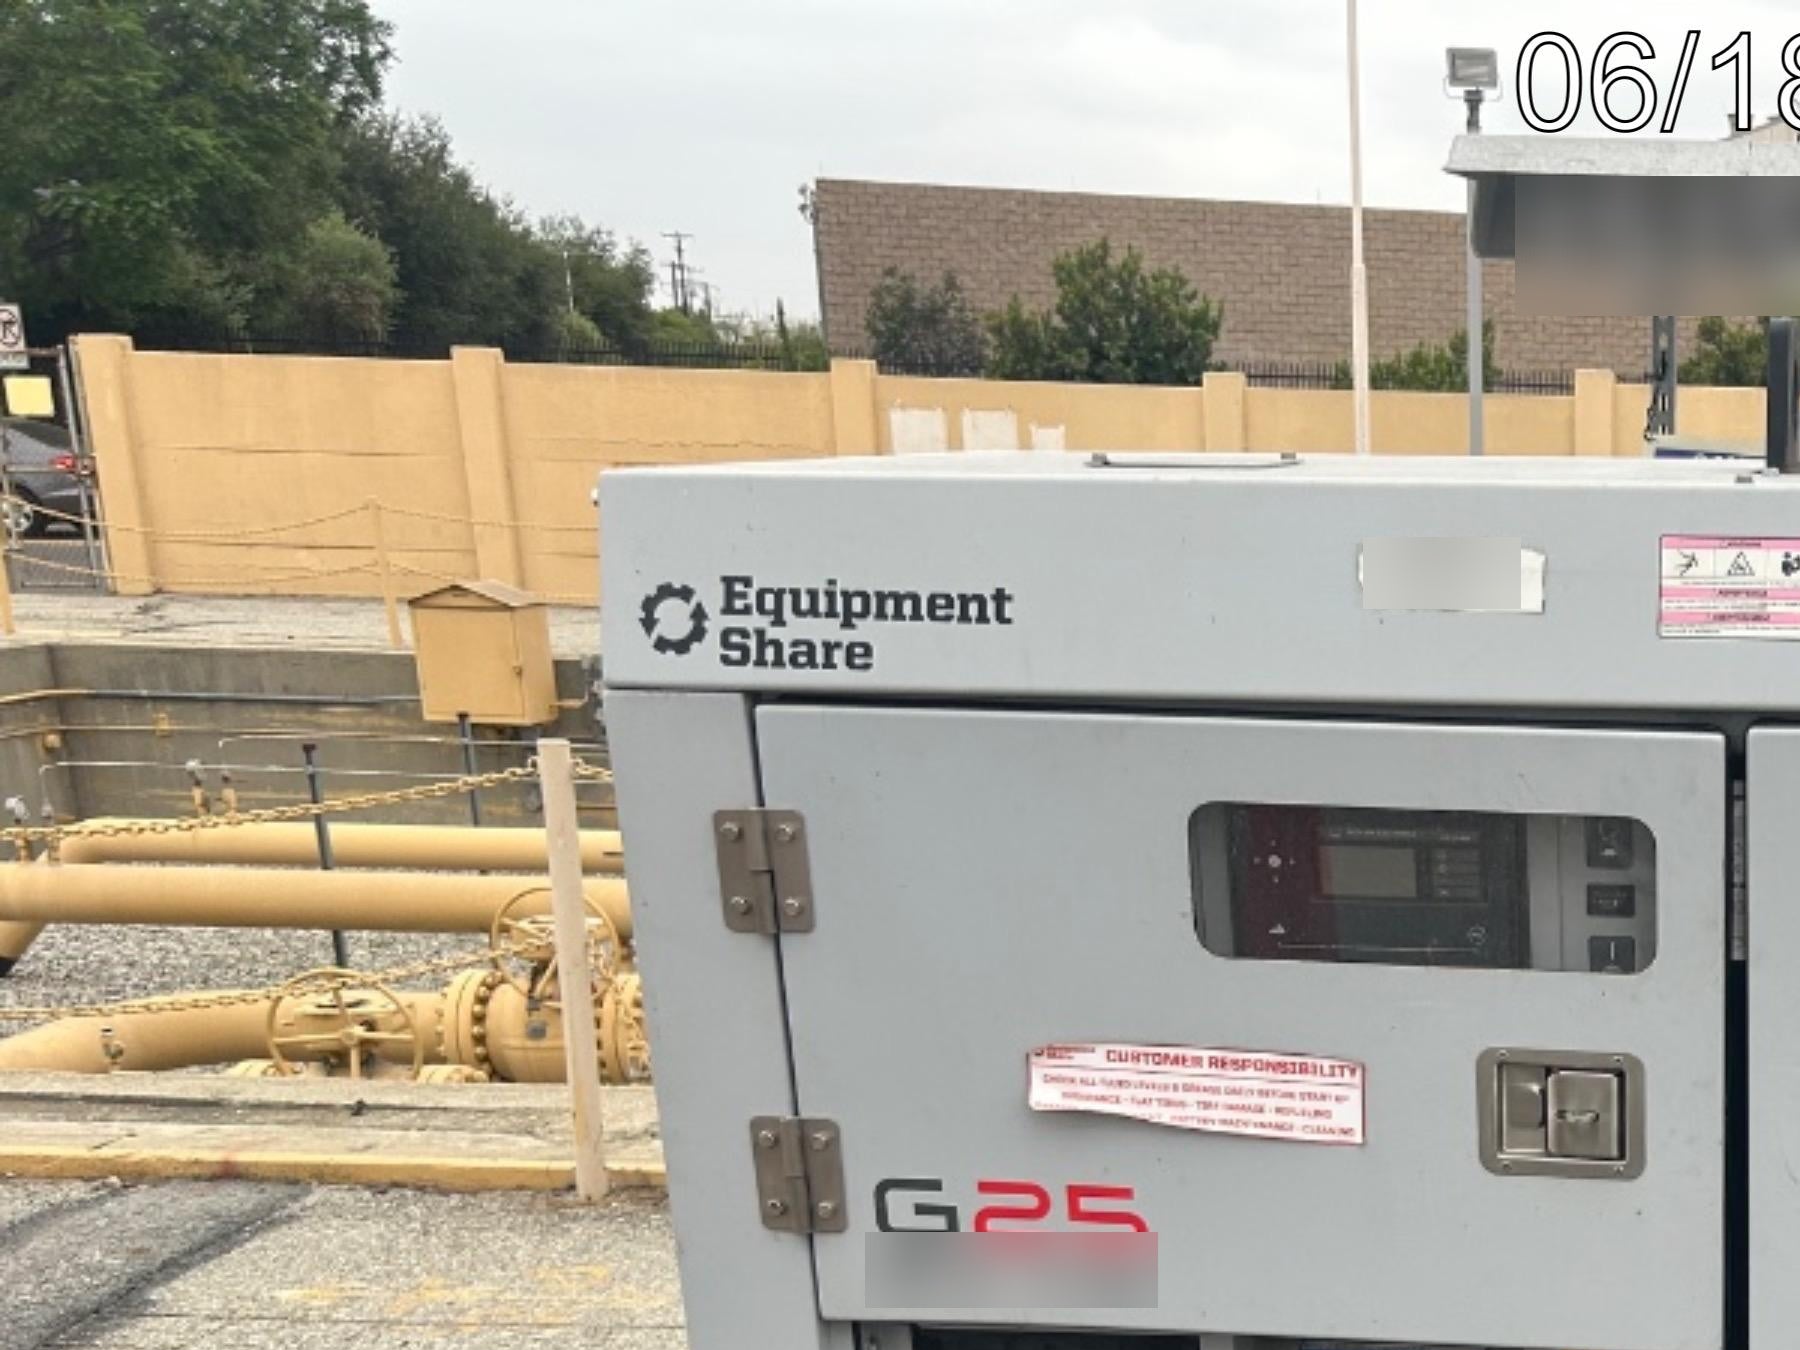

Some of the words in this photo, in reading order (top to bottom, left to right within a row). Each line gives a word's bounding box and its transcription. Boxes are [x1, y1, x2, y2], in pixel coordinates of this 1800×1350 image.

[719, 575, 1014, 630] Equipment
[719, 627, 875, 671] Share
[1106, 1049, 1204, 1069] CUSTOMER
[1208, 1055, 1358, 1079] RESPONSIBILITY
[873, 1177, 1150, 1233] G25
